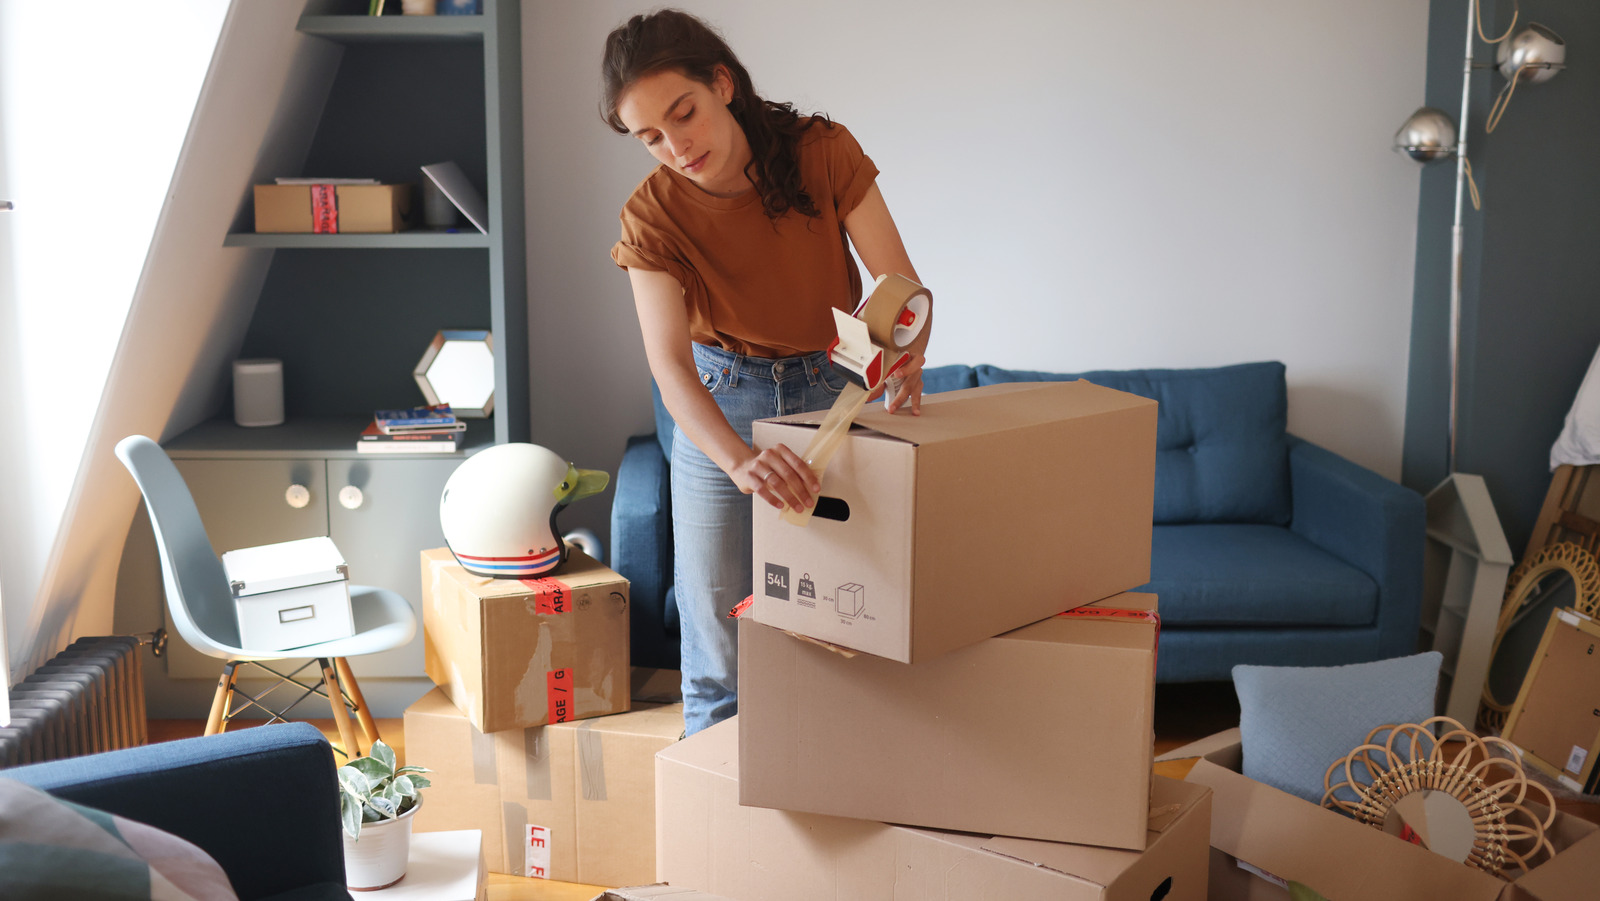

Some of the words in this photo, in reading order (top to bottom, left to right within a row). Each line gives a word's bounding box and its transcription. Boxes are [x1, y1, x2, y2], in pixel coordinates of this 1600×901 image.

[767, 572, 788, 589] 54L
[531, 826, 545, 848] LE
[531, 865, 545, 879] F
